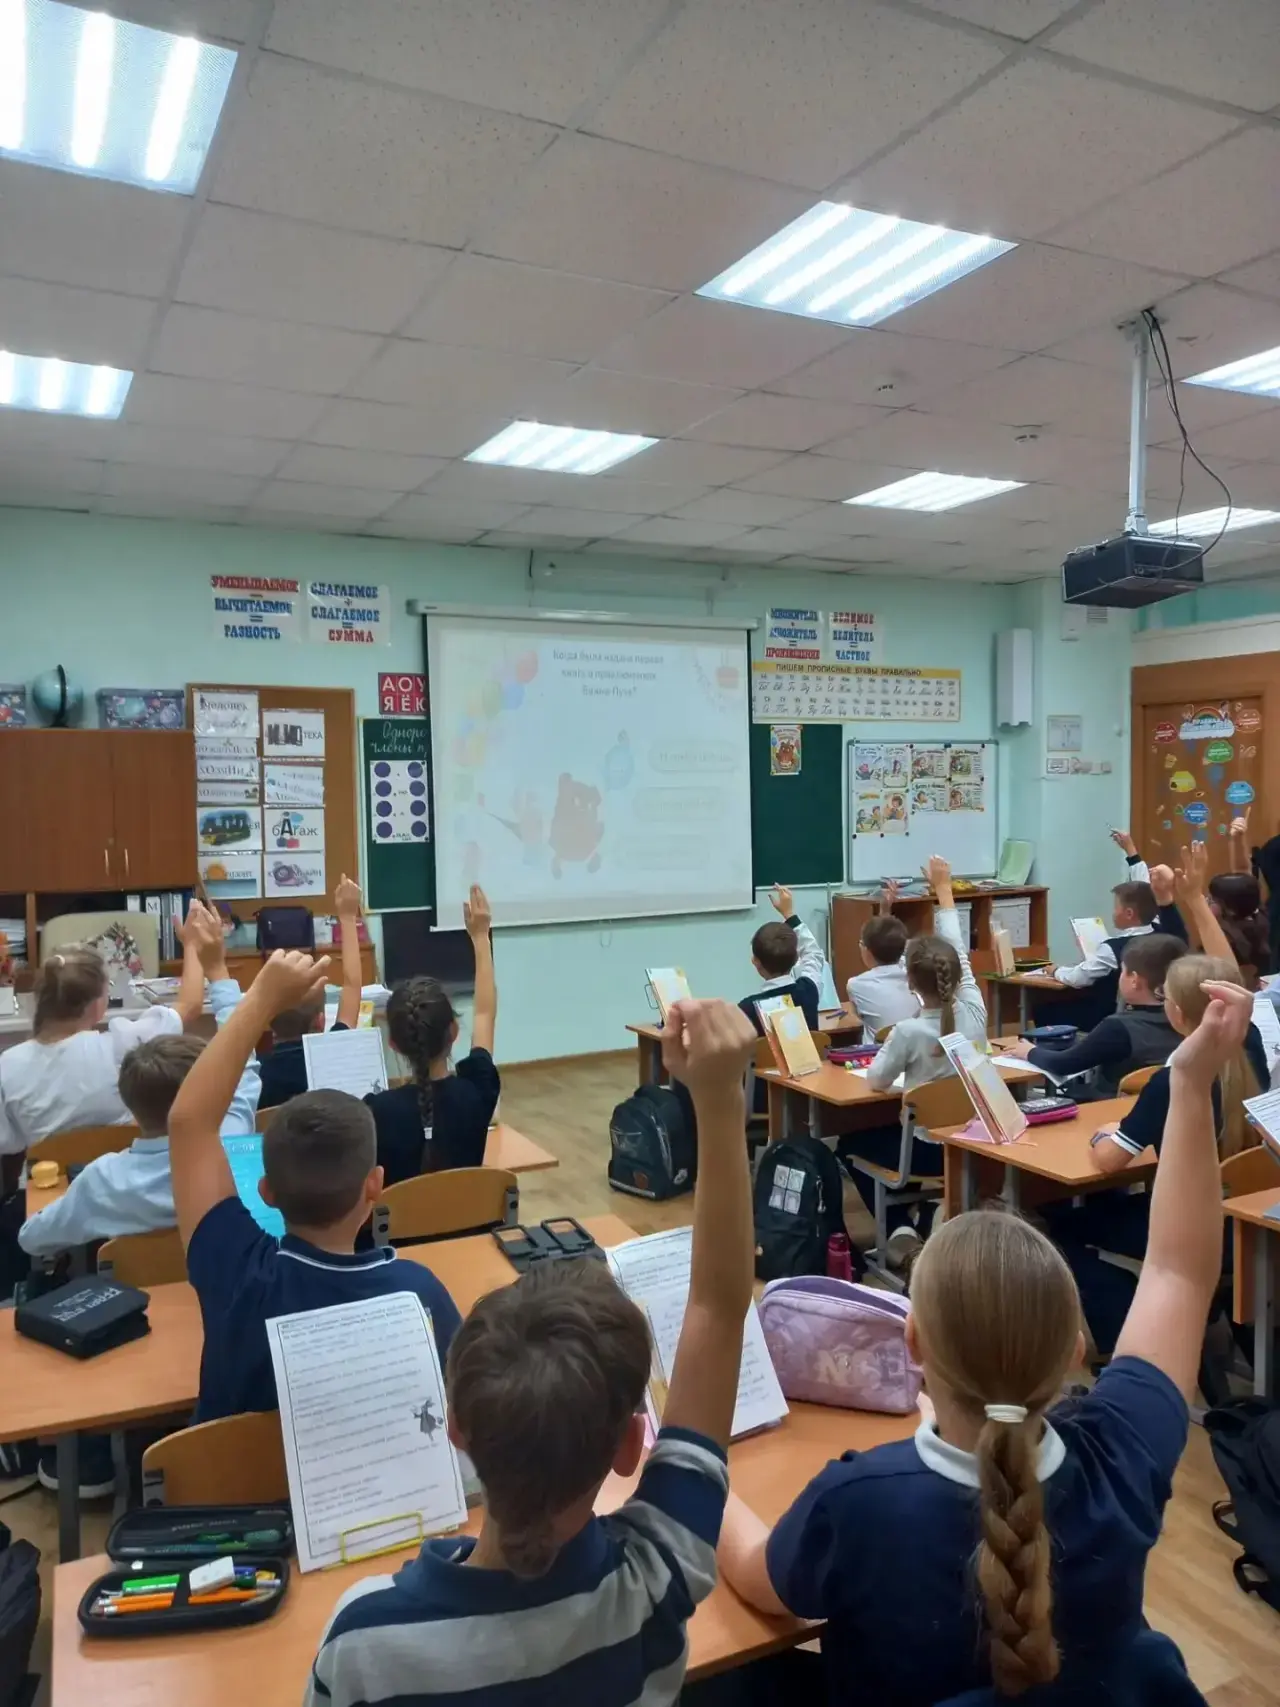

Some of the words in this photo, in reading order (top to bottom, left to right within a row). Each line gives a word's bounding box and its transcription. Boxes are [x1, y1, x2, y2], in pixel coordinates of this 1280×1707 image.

[310, 582, 378, 598] СЛАГАЕМОЕ
[215, 597, 293, 615] ВЫЧИТАЕМОЕ
[311, 606, 380, 622] СЛАГАЕМОЕ
[224, 624, 281, 640] РАЗНОСТЬ
[328, 629, 374, 643] СУММА
[832, 630, 874, 643] ДЕЛИТЕЛЬ
[835, 650, 870, 662] ЧАСТНОЕ
[776, 663, 803, 672] ПИШЕМ
[808, 665, 850, 674] ПРОПИСНЫЕ
[855, 667, 877, 675] БУКВЫ
[881, 668, 921, 677] ПРАВИЛЬНО
